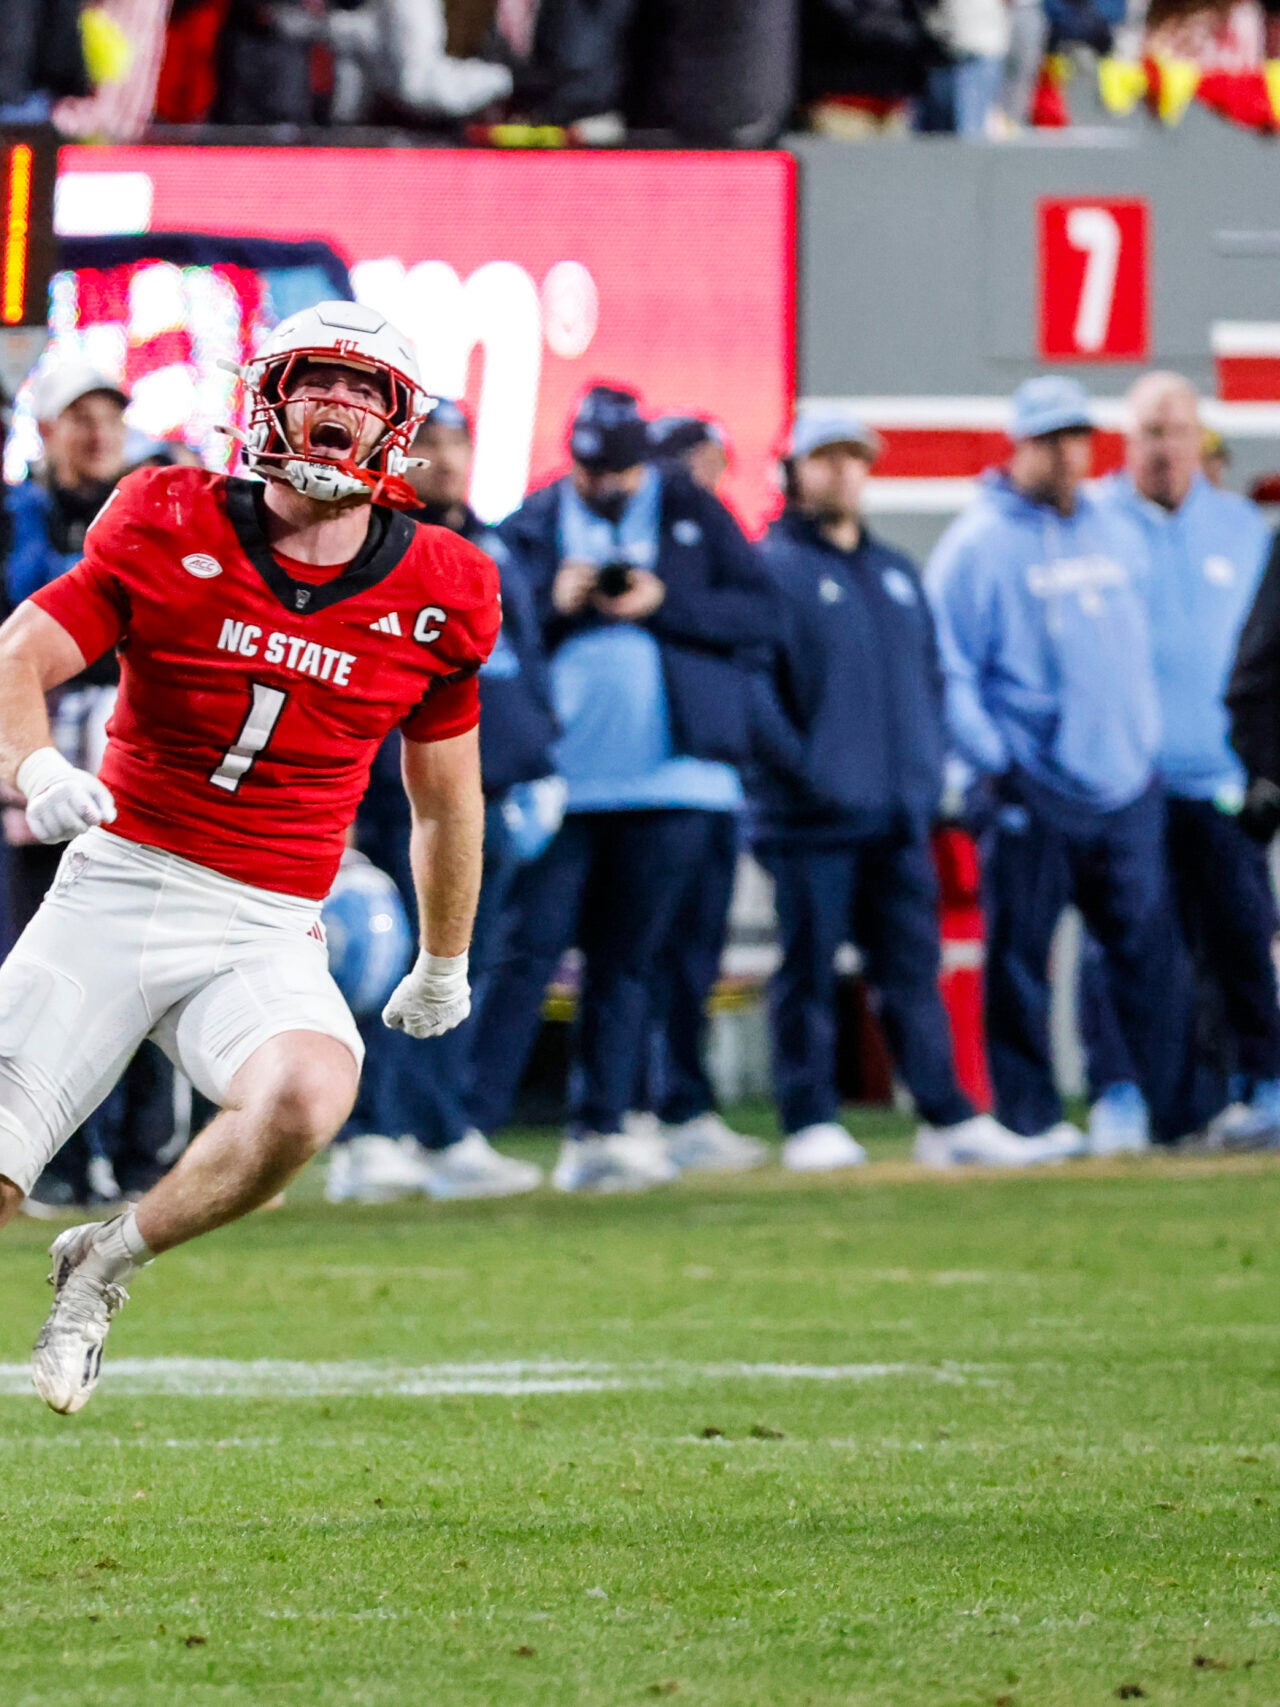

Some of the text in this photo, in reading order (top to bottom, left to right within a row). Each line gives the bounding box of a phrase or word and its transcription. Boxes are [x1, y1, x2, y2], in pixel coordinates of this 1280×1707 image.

[1067, 206, 1122, 352] 7
[191, 559, 216, 571] ACC
[216, 618, 358, 687] NC STATE
[412, 605, 448, 644] C
[207, 680, 289, 794] 1
